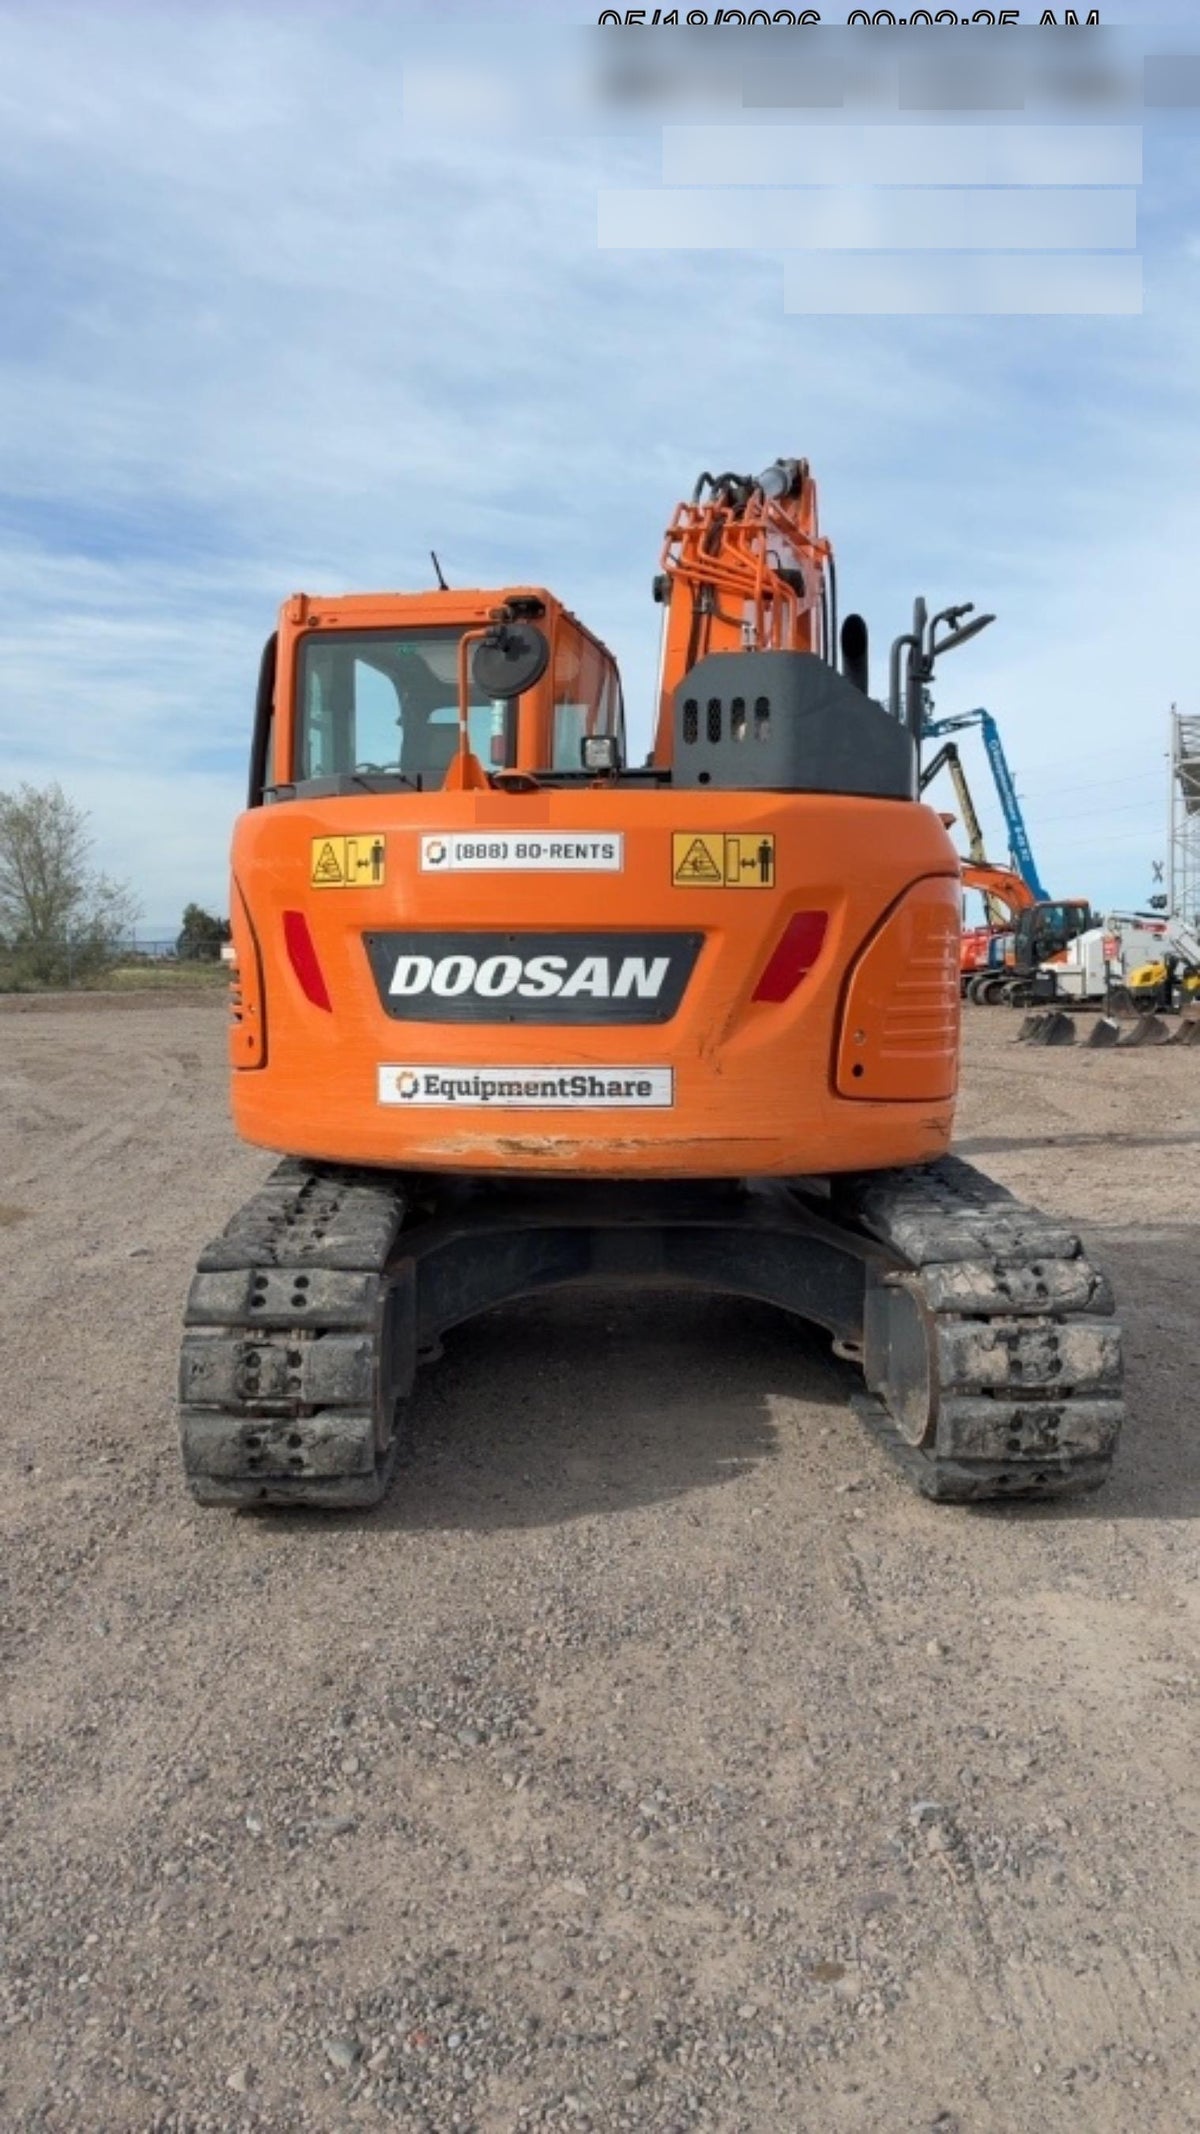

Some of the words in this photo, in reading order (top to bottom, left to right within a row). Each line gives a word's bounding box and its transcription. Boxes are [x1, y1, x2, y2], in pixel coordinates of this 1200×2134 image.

[456, 842, 508, 860] (888)
[514, 843, 615, 860] 80-RENTS
[388, 955, 671, 997] DOOSAN
[424, 1075, 653, 1100] EquipmentShare
